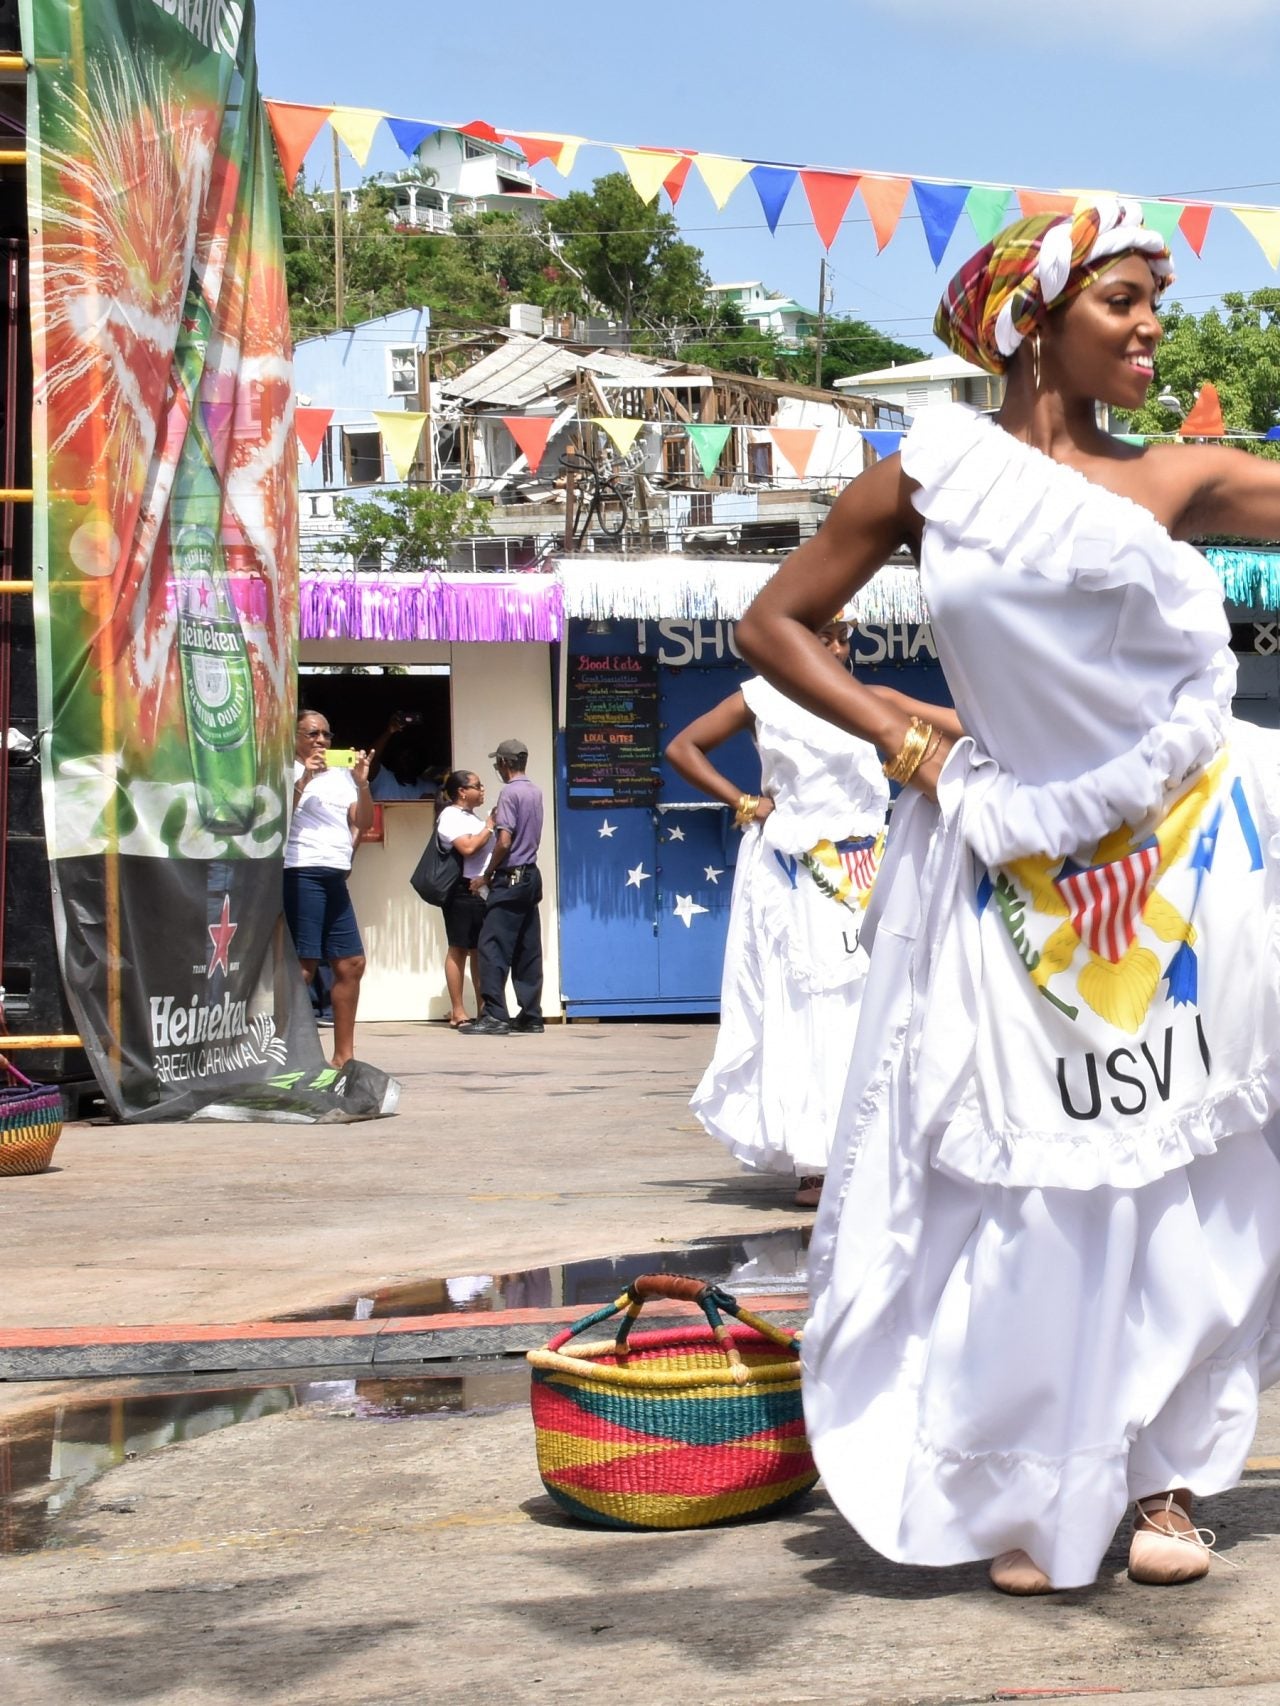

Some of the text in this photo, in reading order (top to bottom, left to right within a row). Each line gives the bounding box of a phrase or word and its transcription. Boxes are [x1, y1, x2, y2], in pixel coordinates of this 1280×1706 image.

[181, 620, 241, 653] Heineken
[578, 654, 641, 670] Good Eats
[187, 679, 244, 728] PREMIUM QUALITY
[153, 1041, 267, 1083] GREEN CARNIVAL
[1056, 1013, 1212, 1121] USVI
